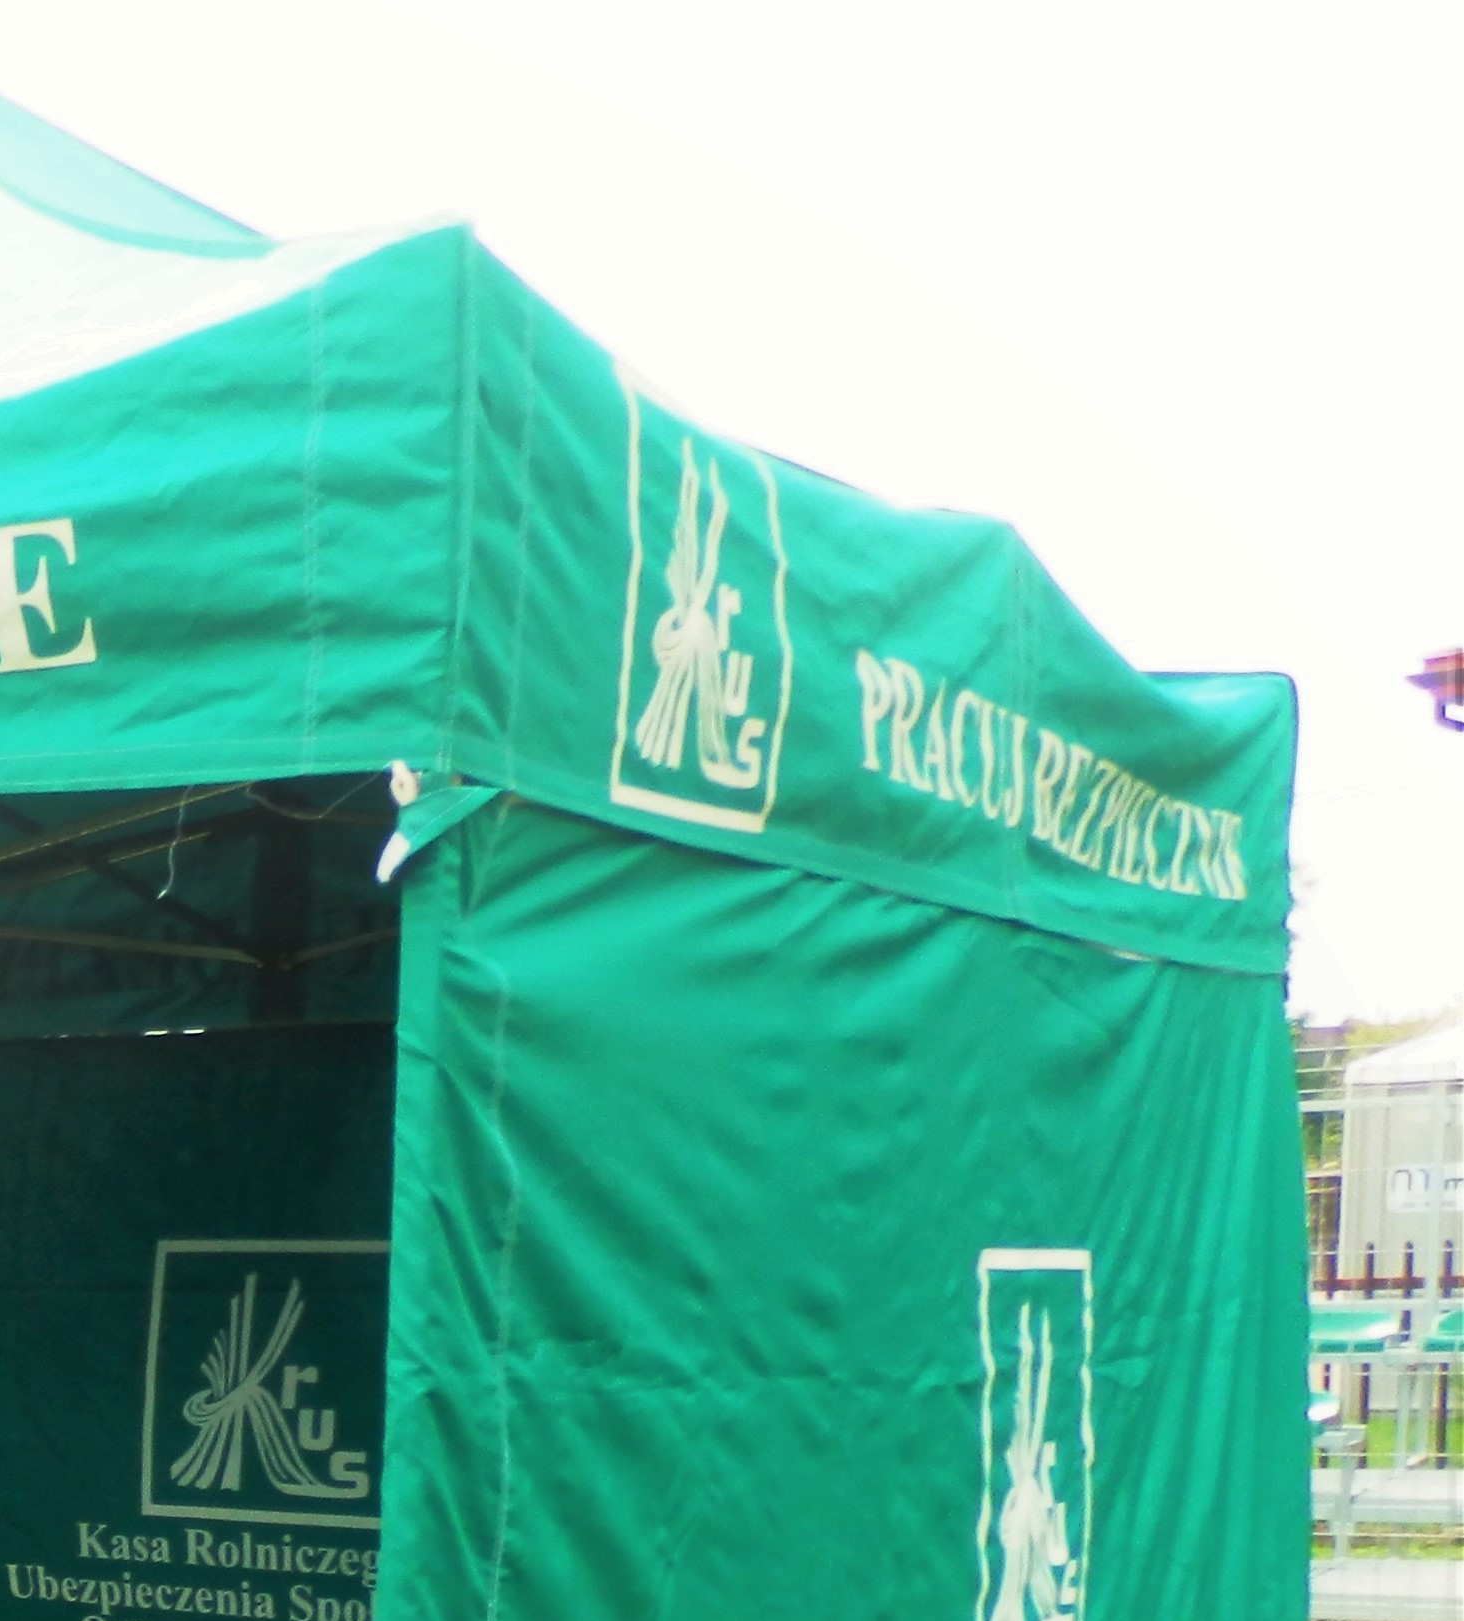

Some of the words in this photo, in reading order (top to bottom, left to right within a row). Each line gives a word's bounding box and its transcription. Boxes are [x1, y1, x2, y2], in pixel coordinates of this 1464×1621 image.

[857, 648, 1029, 828] PRACUJ
[76, 1522, 171, 1565] Kasa
[5, 1563, 276, 1620] Ubezpieczenia
